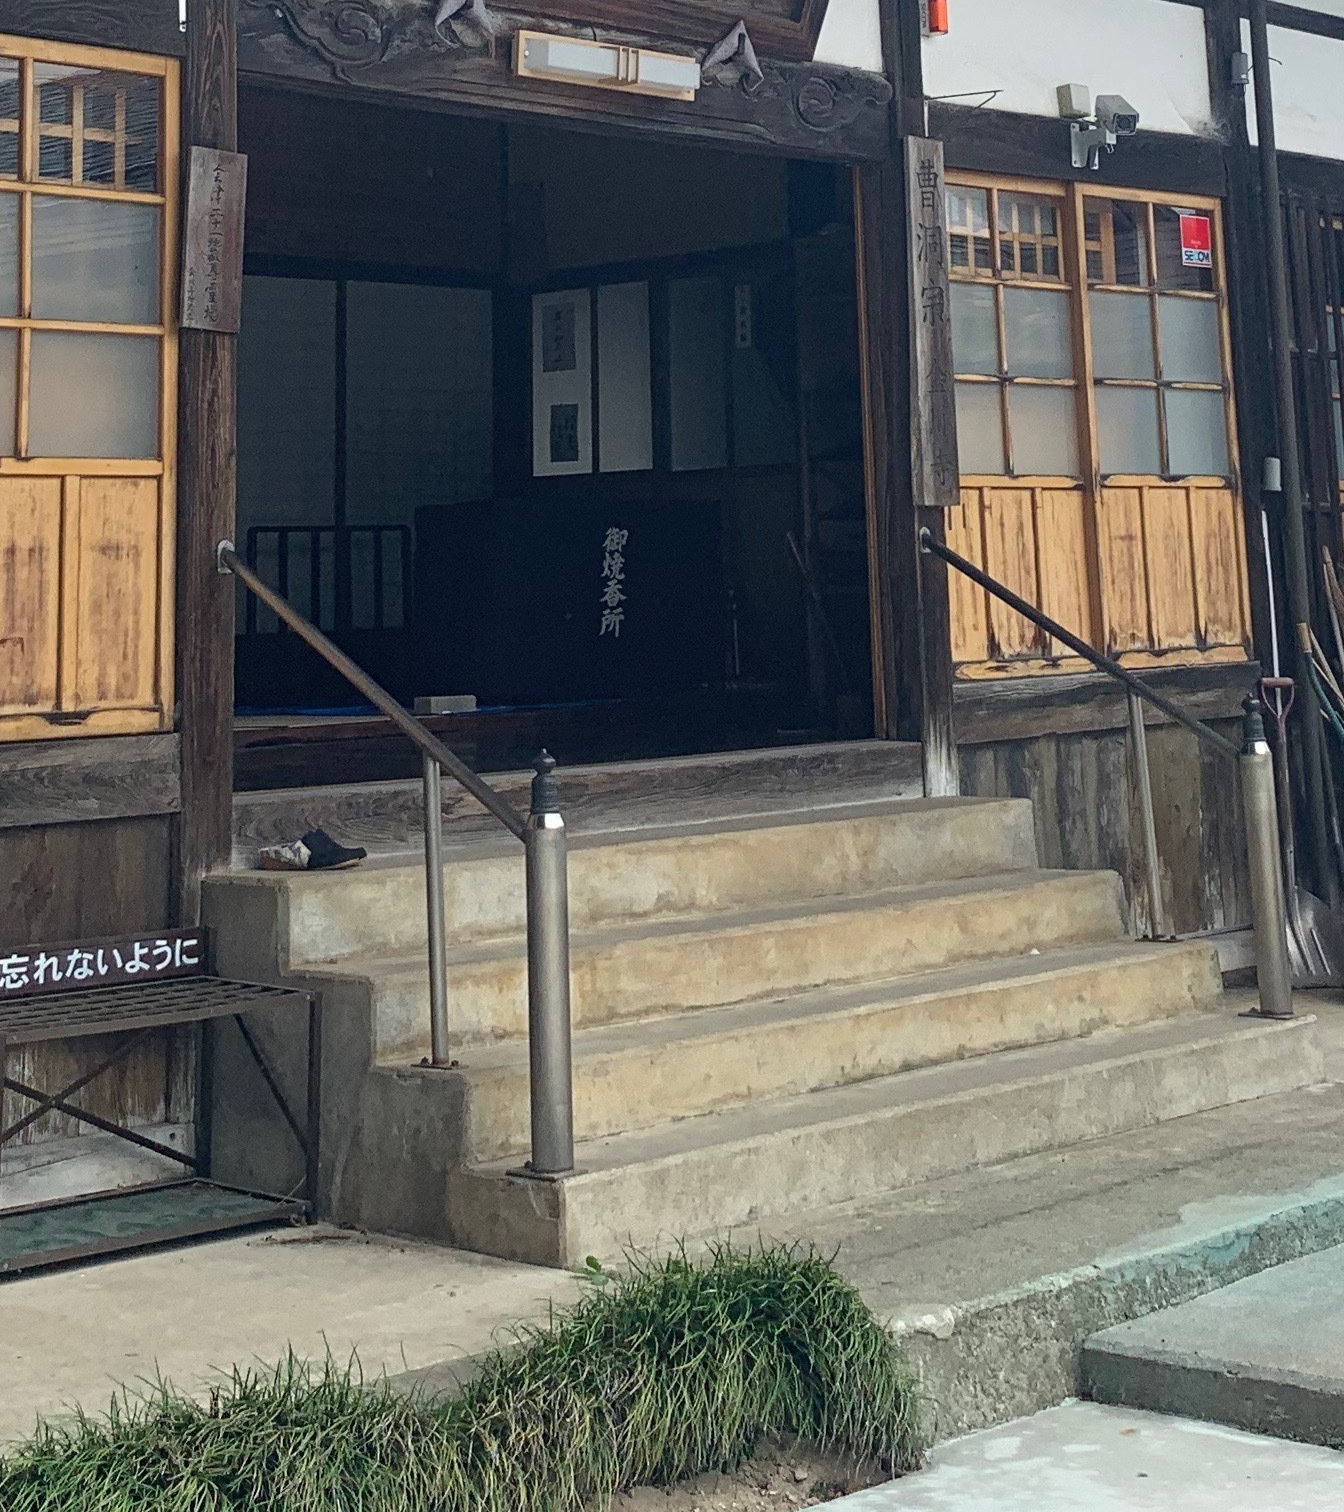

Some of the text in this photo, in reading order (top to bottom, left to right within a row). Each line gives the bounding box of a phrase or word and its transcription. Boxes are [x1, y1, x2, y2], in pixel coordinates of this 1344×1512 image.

[1184, 251, 1209, 262] SECOM
[599, 525, 629, 638] 御焼香所
